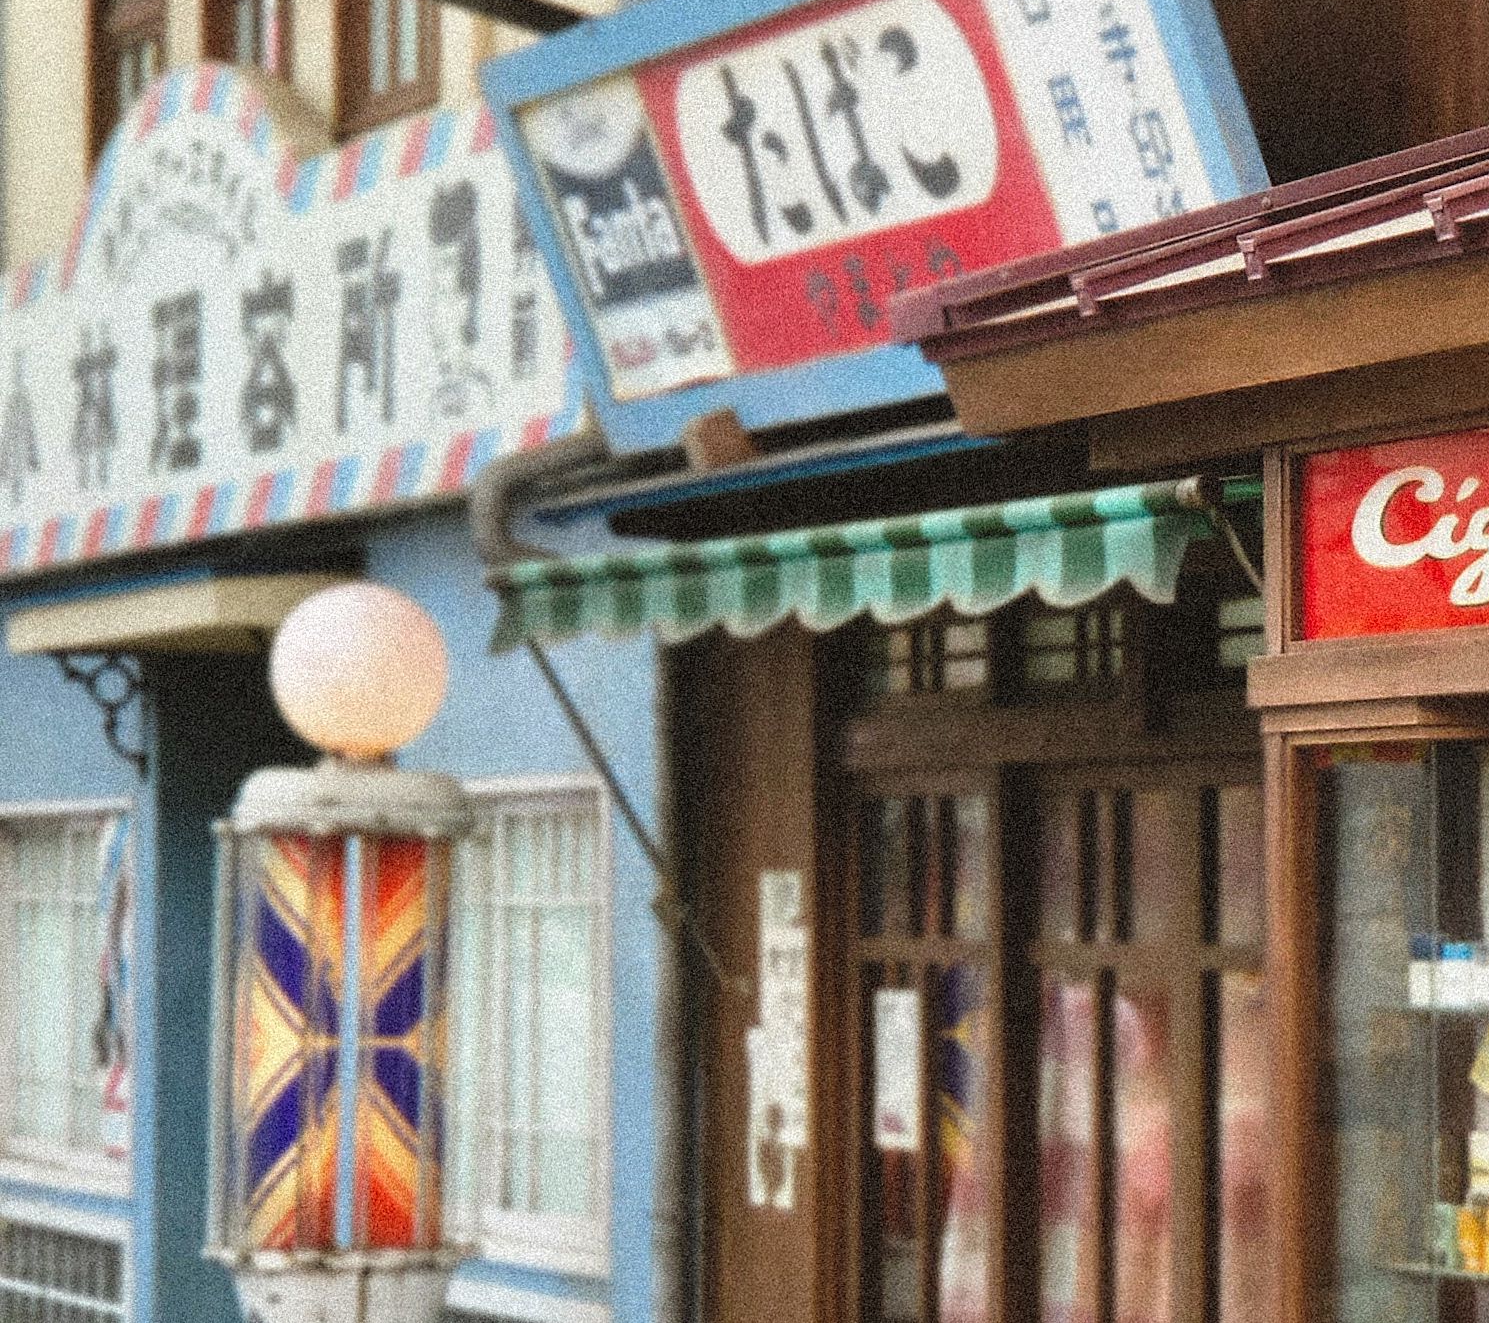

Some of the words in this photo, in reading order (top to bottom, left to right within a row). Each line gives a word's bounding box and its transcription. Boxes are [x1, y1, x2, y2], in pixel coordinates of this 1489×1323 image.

[720, 26, 962, 245] たばこ
[562, 175, 684, 297] Fanta
